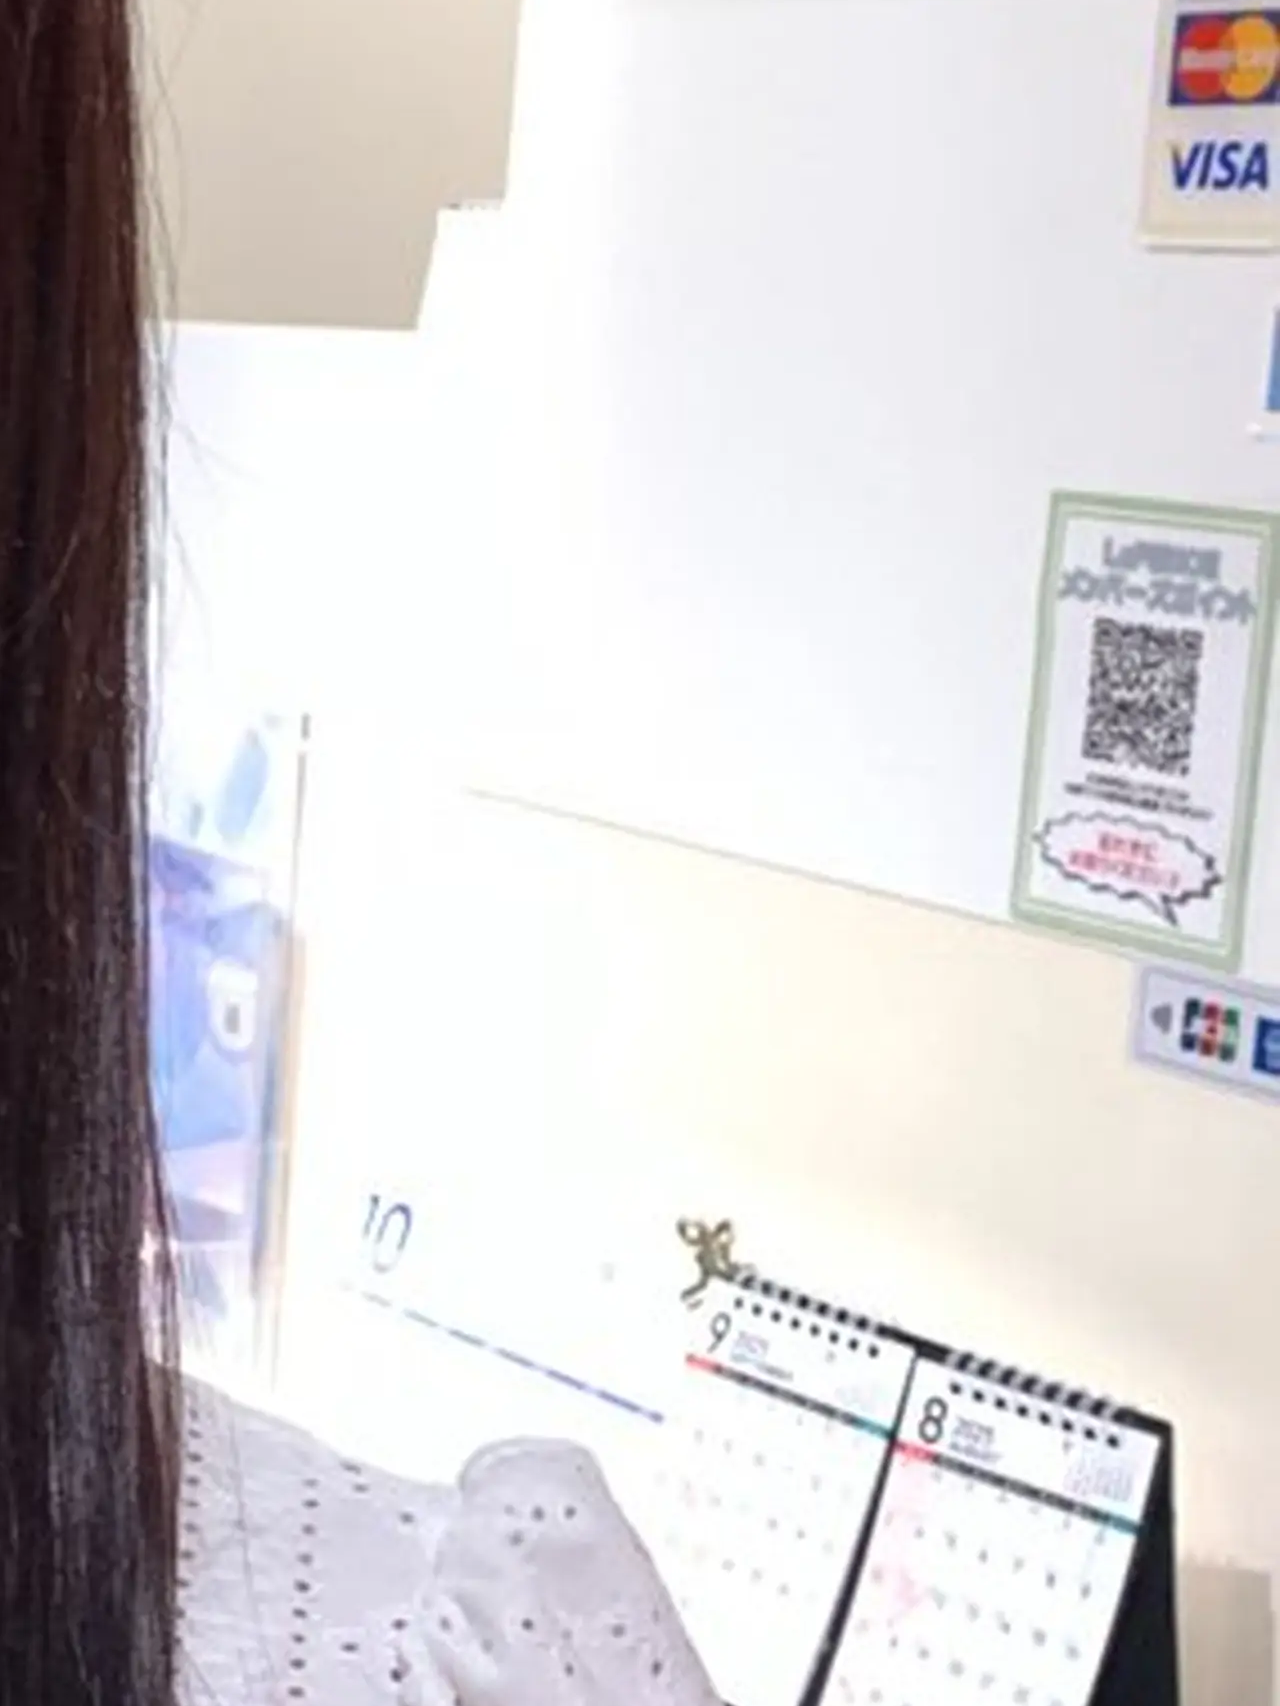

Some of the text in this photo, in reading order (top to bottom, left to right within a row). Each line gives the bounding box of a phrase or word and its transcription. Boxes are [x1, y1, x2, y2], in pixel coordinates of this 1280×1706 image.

[1169, 140, 1269, 191] VISA
[706, 1311, 732, 1354] 9
[918, 1396, 948, 1444] 8
